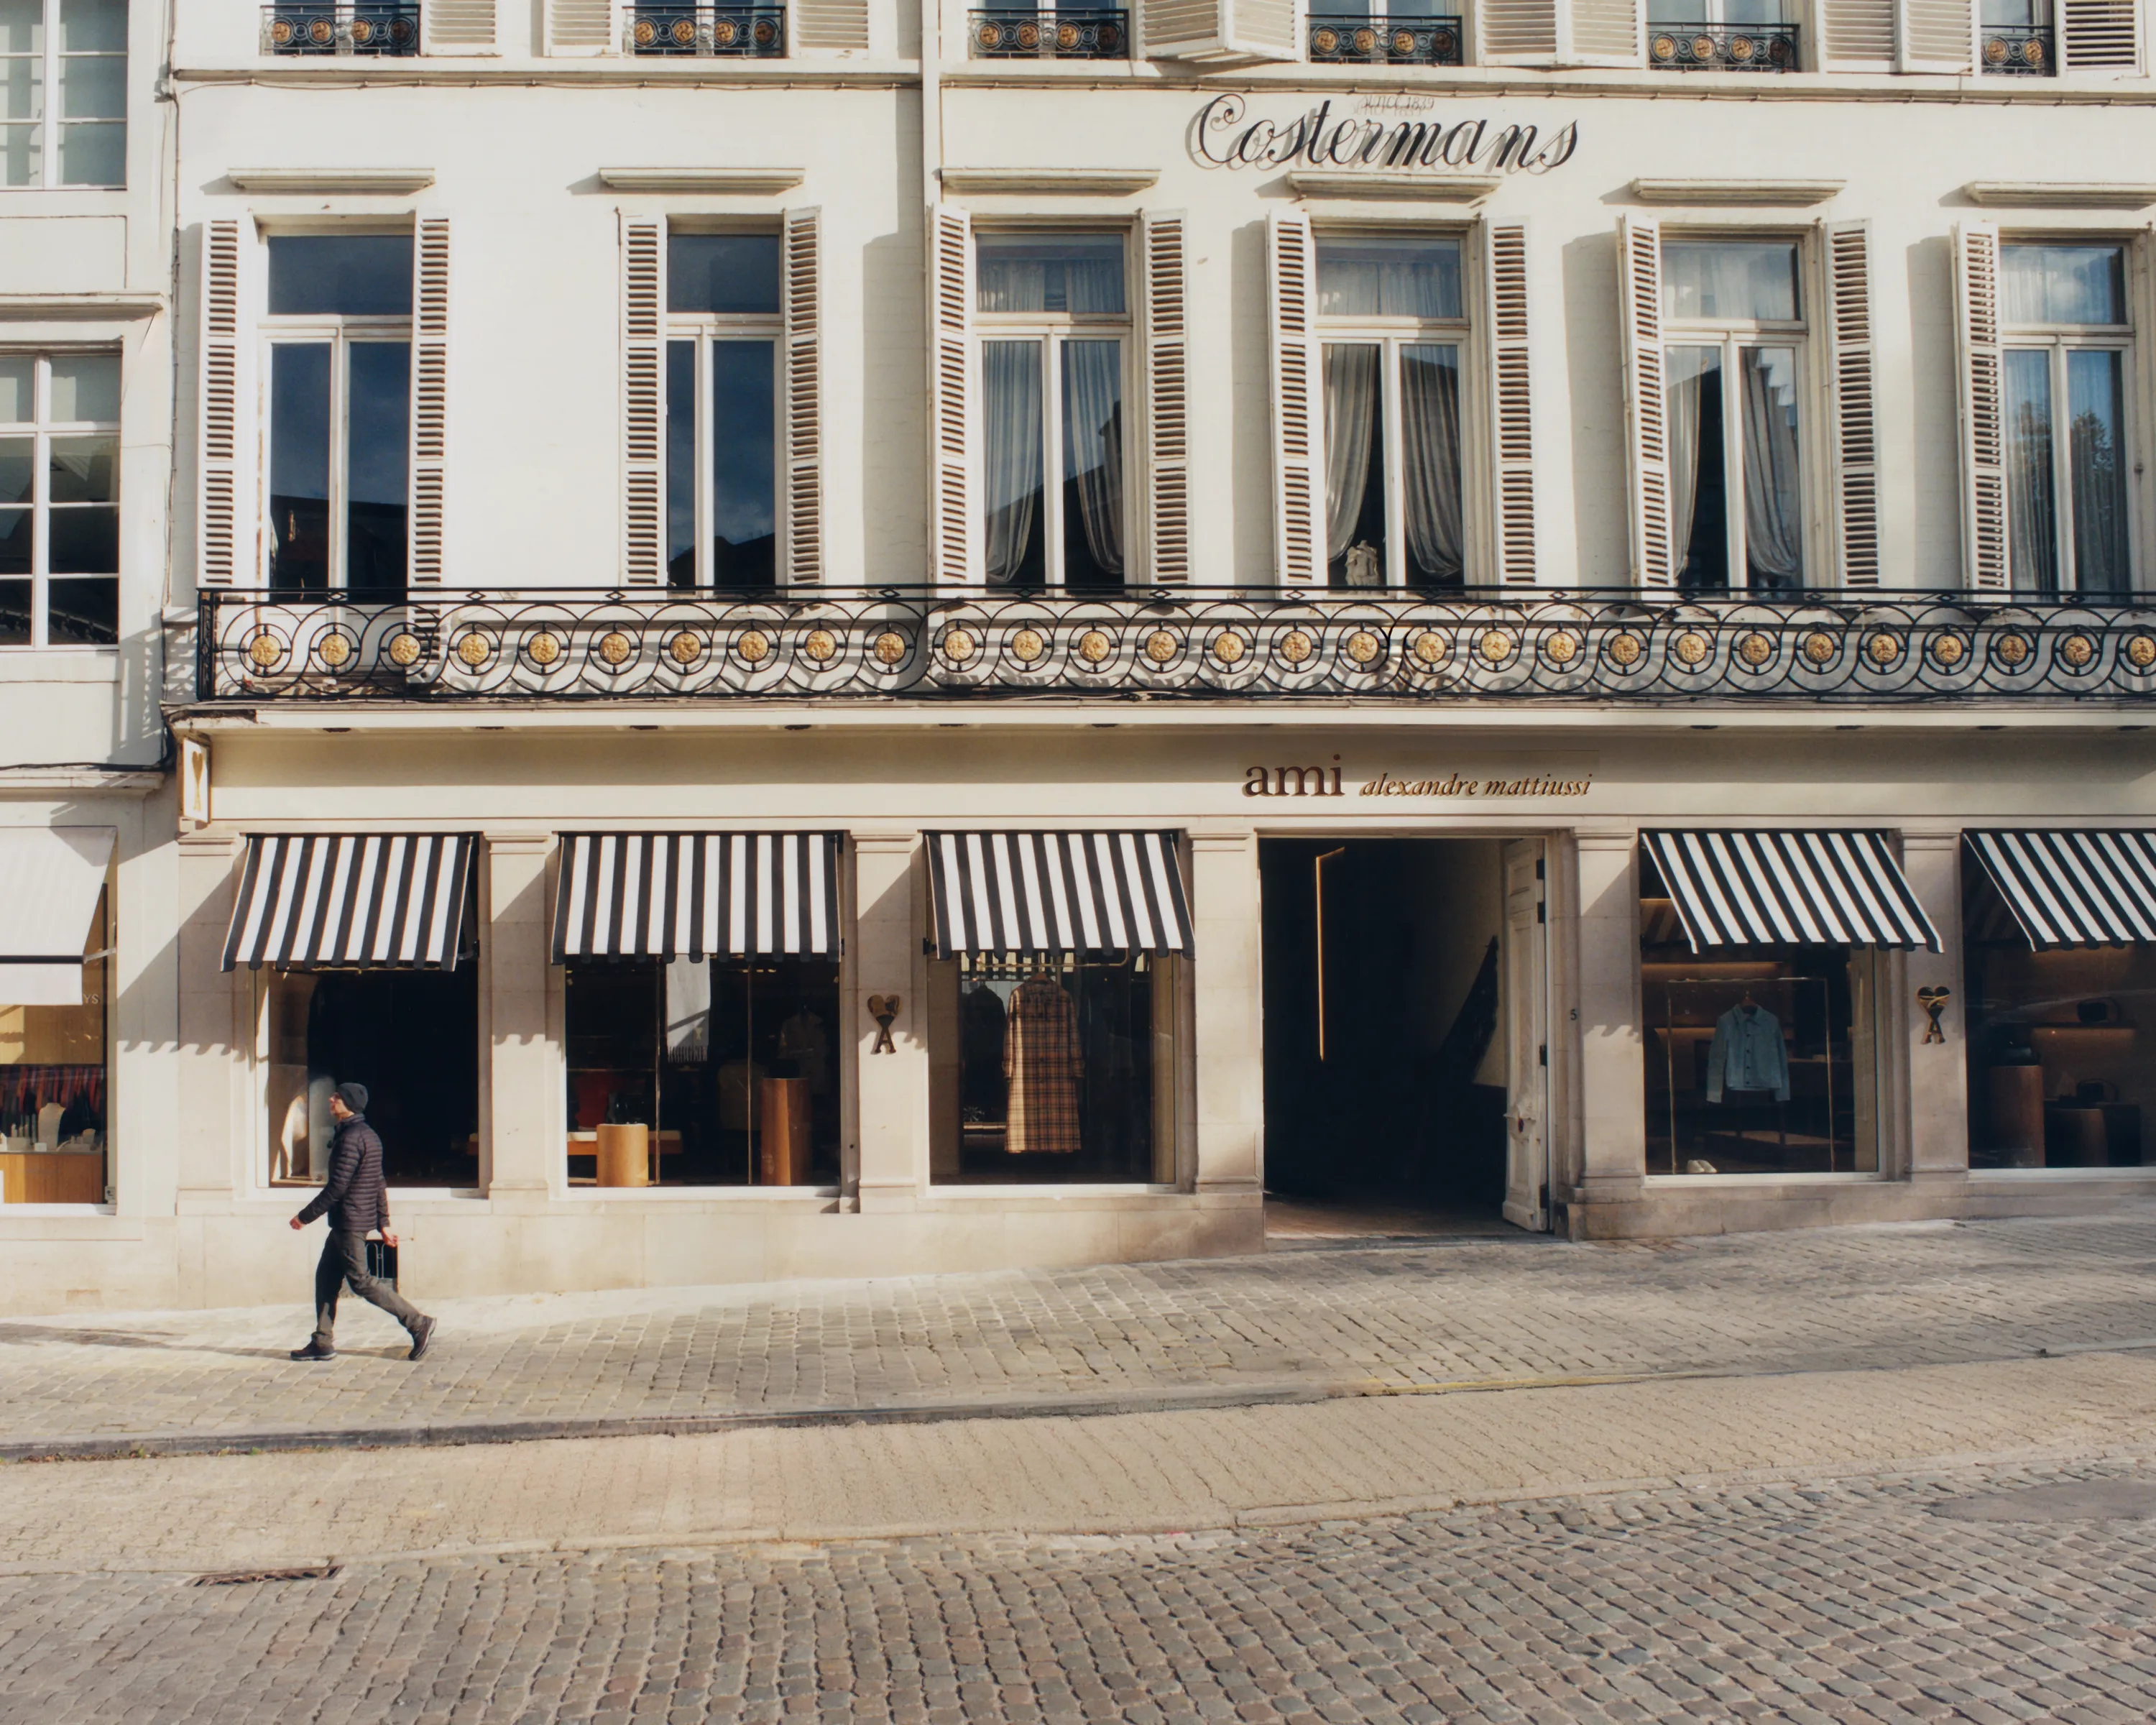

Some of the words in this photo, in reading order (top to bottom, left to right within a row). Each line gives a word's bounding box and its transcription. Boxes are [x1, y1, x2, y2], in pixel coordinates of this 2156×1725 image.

[1197, 93, 1578, 170] Costermans
[1243, 754, 1345, 796] ami
[1359, 772, 1478, 796] alexandre
[1484, 773, 1593, 796] mattiussi
[1570, 1008, 1577, 1021] 5
